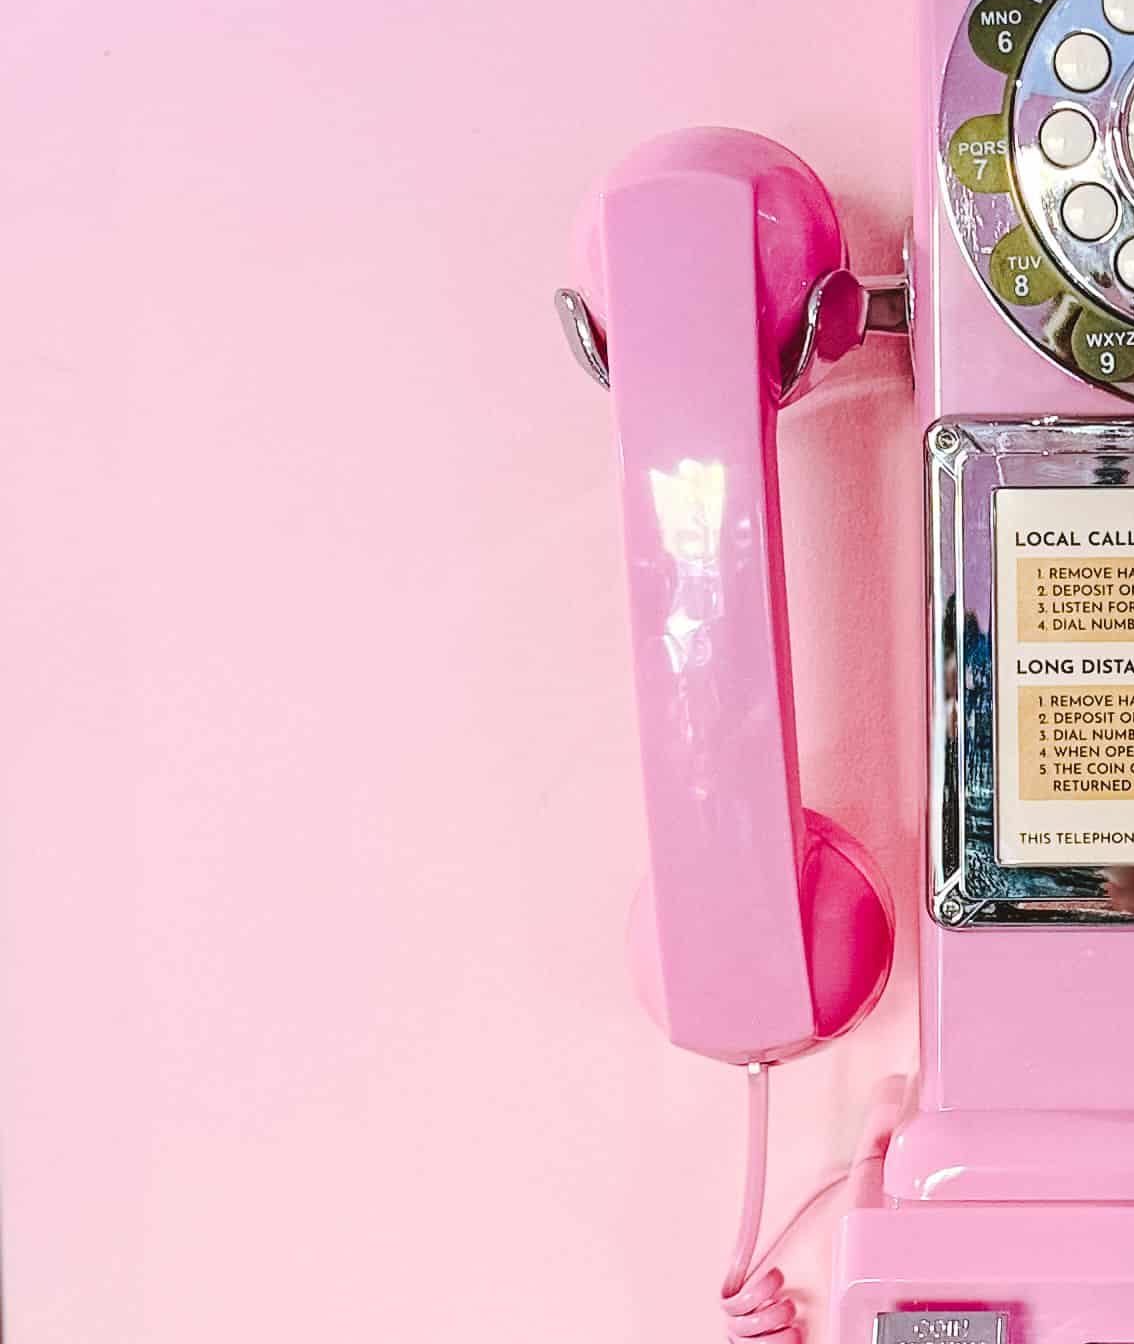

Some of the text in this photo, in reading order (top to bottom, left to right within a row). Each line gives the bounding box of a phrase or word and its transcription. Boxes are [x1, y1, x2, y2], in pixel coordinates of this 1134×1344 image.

[981, 9, 1022, 25] MNO
[998, 30, 1013, 53] 6
[958, 140, 1008, 160] PQRS
[973, 159, 988, 180] 7
[1007, 255, 1042, 270] TUV
[1014, 274, 1029, 297] 8
[1100, 351, 1115, 374] 9
[1015, 531, 1081, 547] LOCAL
[1049, 567, 1113, 580] REMOVE
[1052, 583, 1114, 597] DEPOSIT
[1037, 602, 1048, 614] 3.
[1052, 601, 1103, 614] LISTEN
[1052, 618, 1086, 631] DIAL
[1016, 659, 1074, 675] LONG
[1050, 694, 1114, 707] REMOVE
[1053, 711, 1115, 724] DEPOSIT
[1053, 728, 1088, 742] DIAL
[1053, 745, 1100, 758] WHEN
[1053, 762, 1082, 775] THE
[1086, 762, 1125, 775] COIN
[1053, 779, 1132, 792] RETURNED
[1019, 832, 1052, 845] THIS
